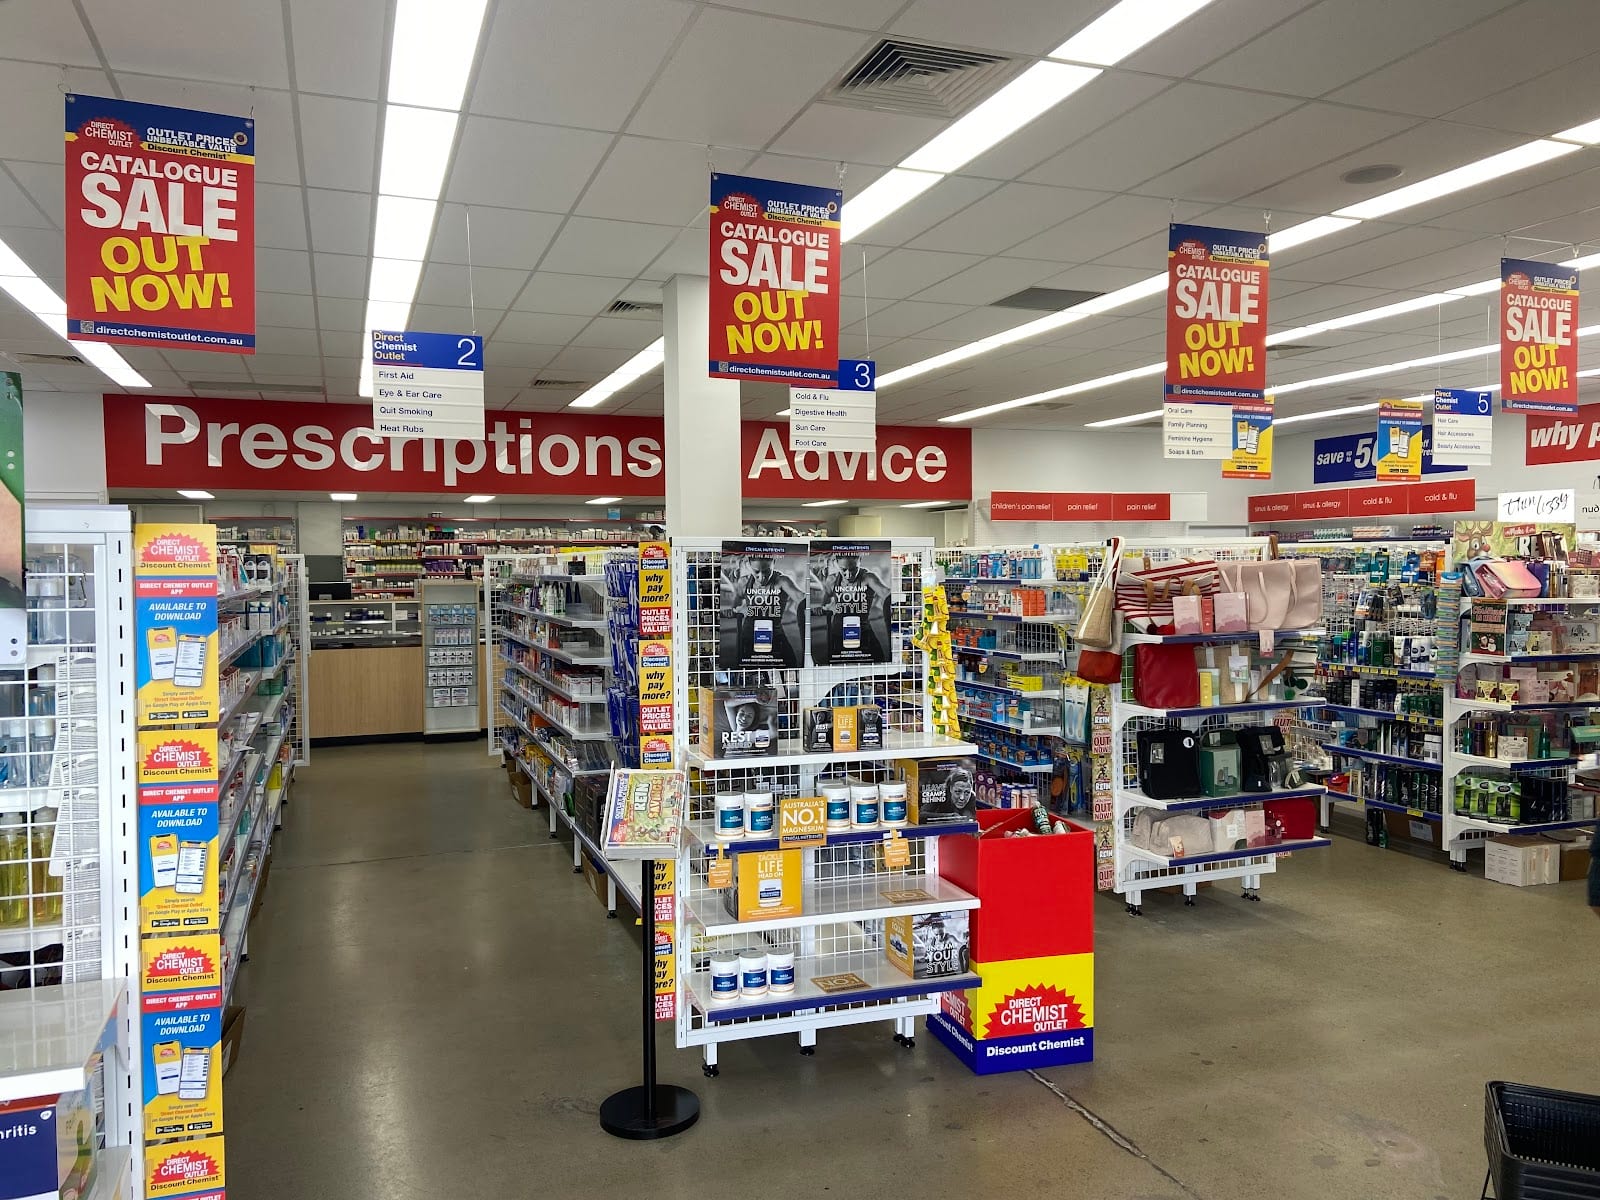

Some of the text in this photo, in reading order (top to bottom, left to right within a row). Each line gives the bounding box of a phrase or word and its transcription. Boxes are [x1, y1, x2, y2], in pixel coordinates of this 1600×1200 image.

[91, 121, 114, 131] DIRECT
[85, 127, 132, 142] CHEMIST
[146, 127, 237, 146] OUTLET PRICES
[108, 138, 133, 148] OUTLET
[147, 144, 227, 160] Discount Chemist
[80, 151, 238, 188] CATALOGUE
[80, 172, 238, 242] SALE
[724, 201, 758, 212] CHEMIST
[720, 222, 830, 248] CATALOGUE
[100, 236, 210, 273] OUT
[720, 239, 829, 294] SALE
[1176, 264, 1260, 284] CATALOGUE
[90, 273, 233, 313] NOW!
[733, 290, 810, 322] OUT
[1175, 279, 1259, 324] SALE
[1506, 294, 1572, 312] CATALOGUE
[1506, 307, 1571, 346] SALE
[96, 325, 243, 346] directchemistoutlet.com.au
[374, 332, 404, 342] Direct
[726, 320, 824, 355] NOW!
[1185, 320, 1244, 351] OUT
[374, 341, 417, 351] Chemist
[457, 338, 476, 366] 2
[375, 351, 405, 360] Outlet
[1514, 344, 1559, 370] OUT
[1179, 346, 1254, 379] NOW!
[729, 365, 830, 380] directchemistoutlet.com.au
[855, 363, 870, 388] 3
[1510, 366, 1568, 394] NOW!
[379, 389, 394, 397] Eye
[1478, 393, 1488, 413] 5
[398, 407, 433, 417] Smoking
[1530, 420, 1584, 450] why
[144, 402, 663, 487] Prescriptions
[748, 428, 948, 483] Advice
[1316, 452, 1344, 465] save
[1449, 492, 1457, 500] flu
[1272, 504, 1289, 512] allergy
[1322, 500, 1341, 510] allergy
[150, 545, 199, 556] CHEMIST
[645, 574, 664, 583] why
[647, 584, 663, 593] pay
[641, 593, 669, 603] more?
[747, 596, 780, 606] YOUR
[835, 593, 867, 603] YOUR
[149, 603, 194, 611] AVAILABLE
[747, 605, 781, 617] STYLE
[835, 602, 868, 613] STYLE
[154, 612, 202, 620] DOWNLOAD
[646, 671, 665, 681] why
[648, 681, 664, 691] pay
[641, 690, 670, 700] more?
[722, 731, 751, 744] REST
[1094, 736, 1110, 745] OUT
[784, 800, 824, 808] AUSTRALIA'S
[782, 808, 824, 826] NO.1
[782, 825, 824, 834] MAGNESIUM
[758, 860, 783, 873] LIFE
[162, 952, 185, 961] DIRECT
[926, 951, 958, 962] YOUR
[156, 957, 203, 970] CHEMIST
[926, 962, 959, 974] STYLE
[180, 966, 204, 975] OUTLET
[146, 973, 215, 984] Discount Chemist
[1009, 996, 1042, 1008] DIRECT
[155, 1014, 210, 1026] AVAILABLE TO
[1001, 1004, 1067, 1026] CHEMIST
[160, 1024, 205, 1035] DOWNLOAD
[1034, 1020, 1068, 1032] OUTLET
[987, 1037, 1085, 1056] Discount Chemist
[167, 1156, 190, 1166] DIRECT
[161, 1160, 208, 1176] CHEMIST
[184, 1169, 208, 1179] OUTLET
[150, 1175, 218, 1191] Discount Chemist
